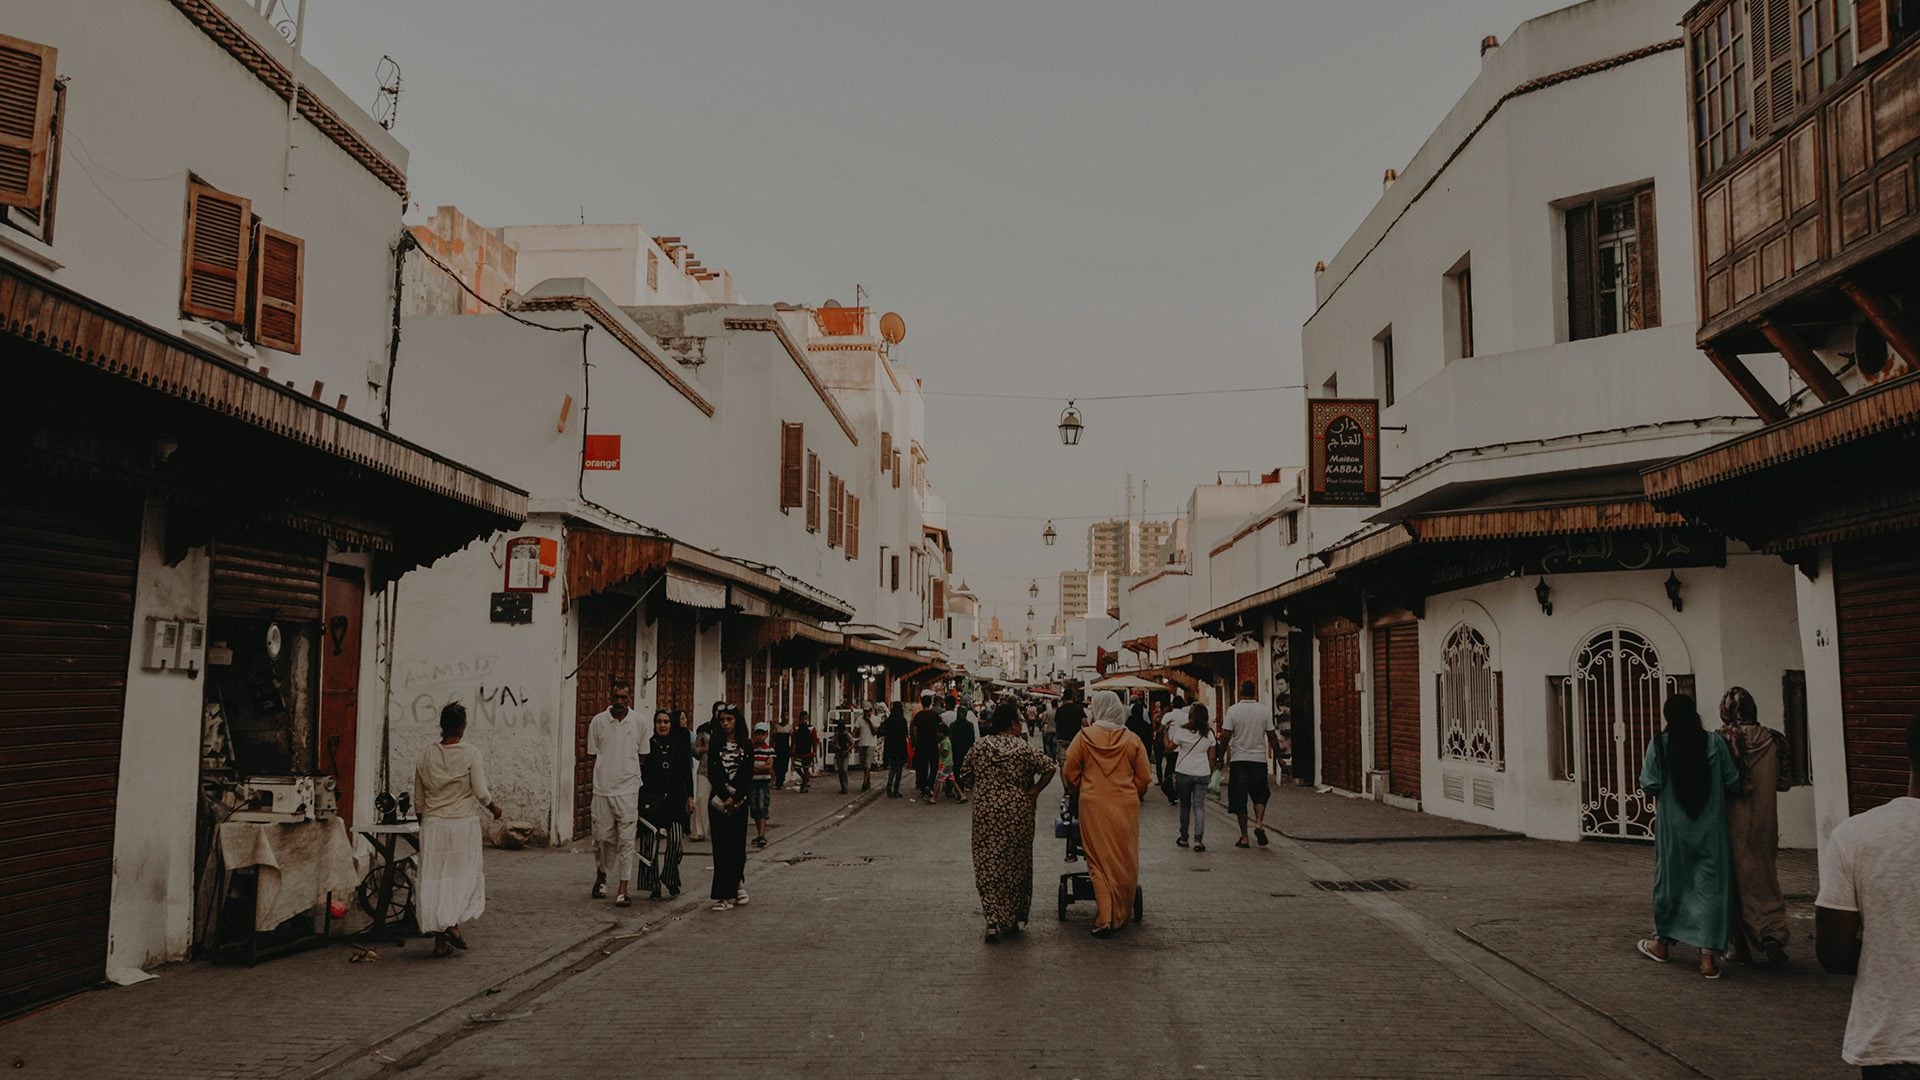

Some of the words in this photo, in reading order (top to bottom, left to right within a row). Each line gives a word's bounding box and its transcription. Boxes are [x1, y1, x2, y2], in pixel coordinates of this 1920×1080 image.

[1330, 417, 1359, 433] دار
[1327, 433, 1361, 451] القباج
[585, 459, 618, 469] orange
[1329, 455, 1360, 464] Maison
[1325, 464, 1364, 474] KABBAJ
[1541, 529, 1613, 574] القباج
[1617, 526, 1690, 570] دار
